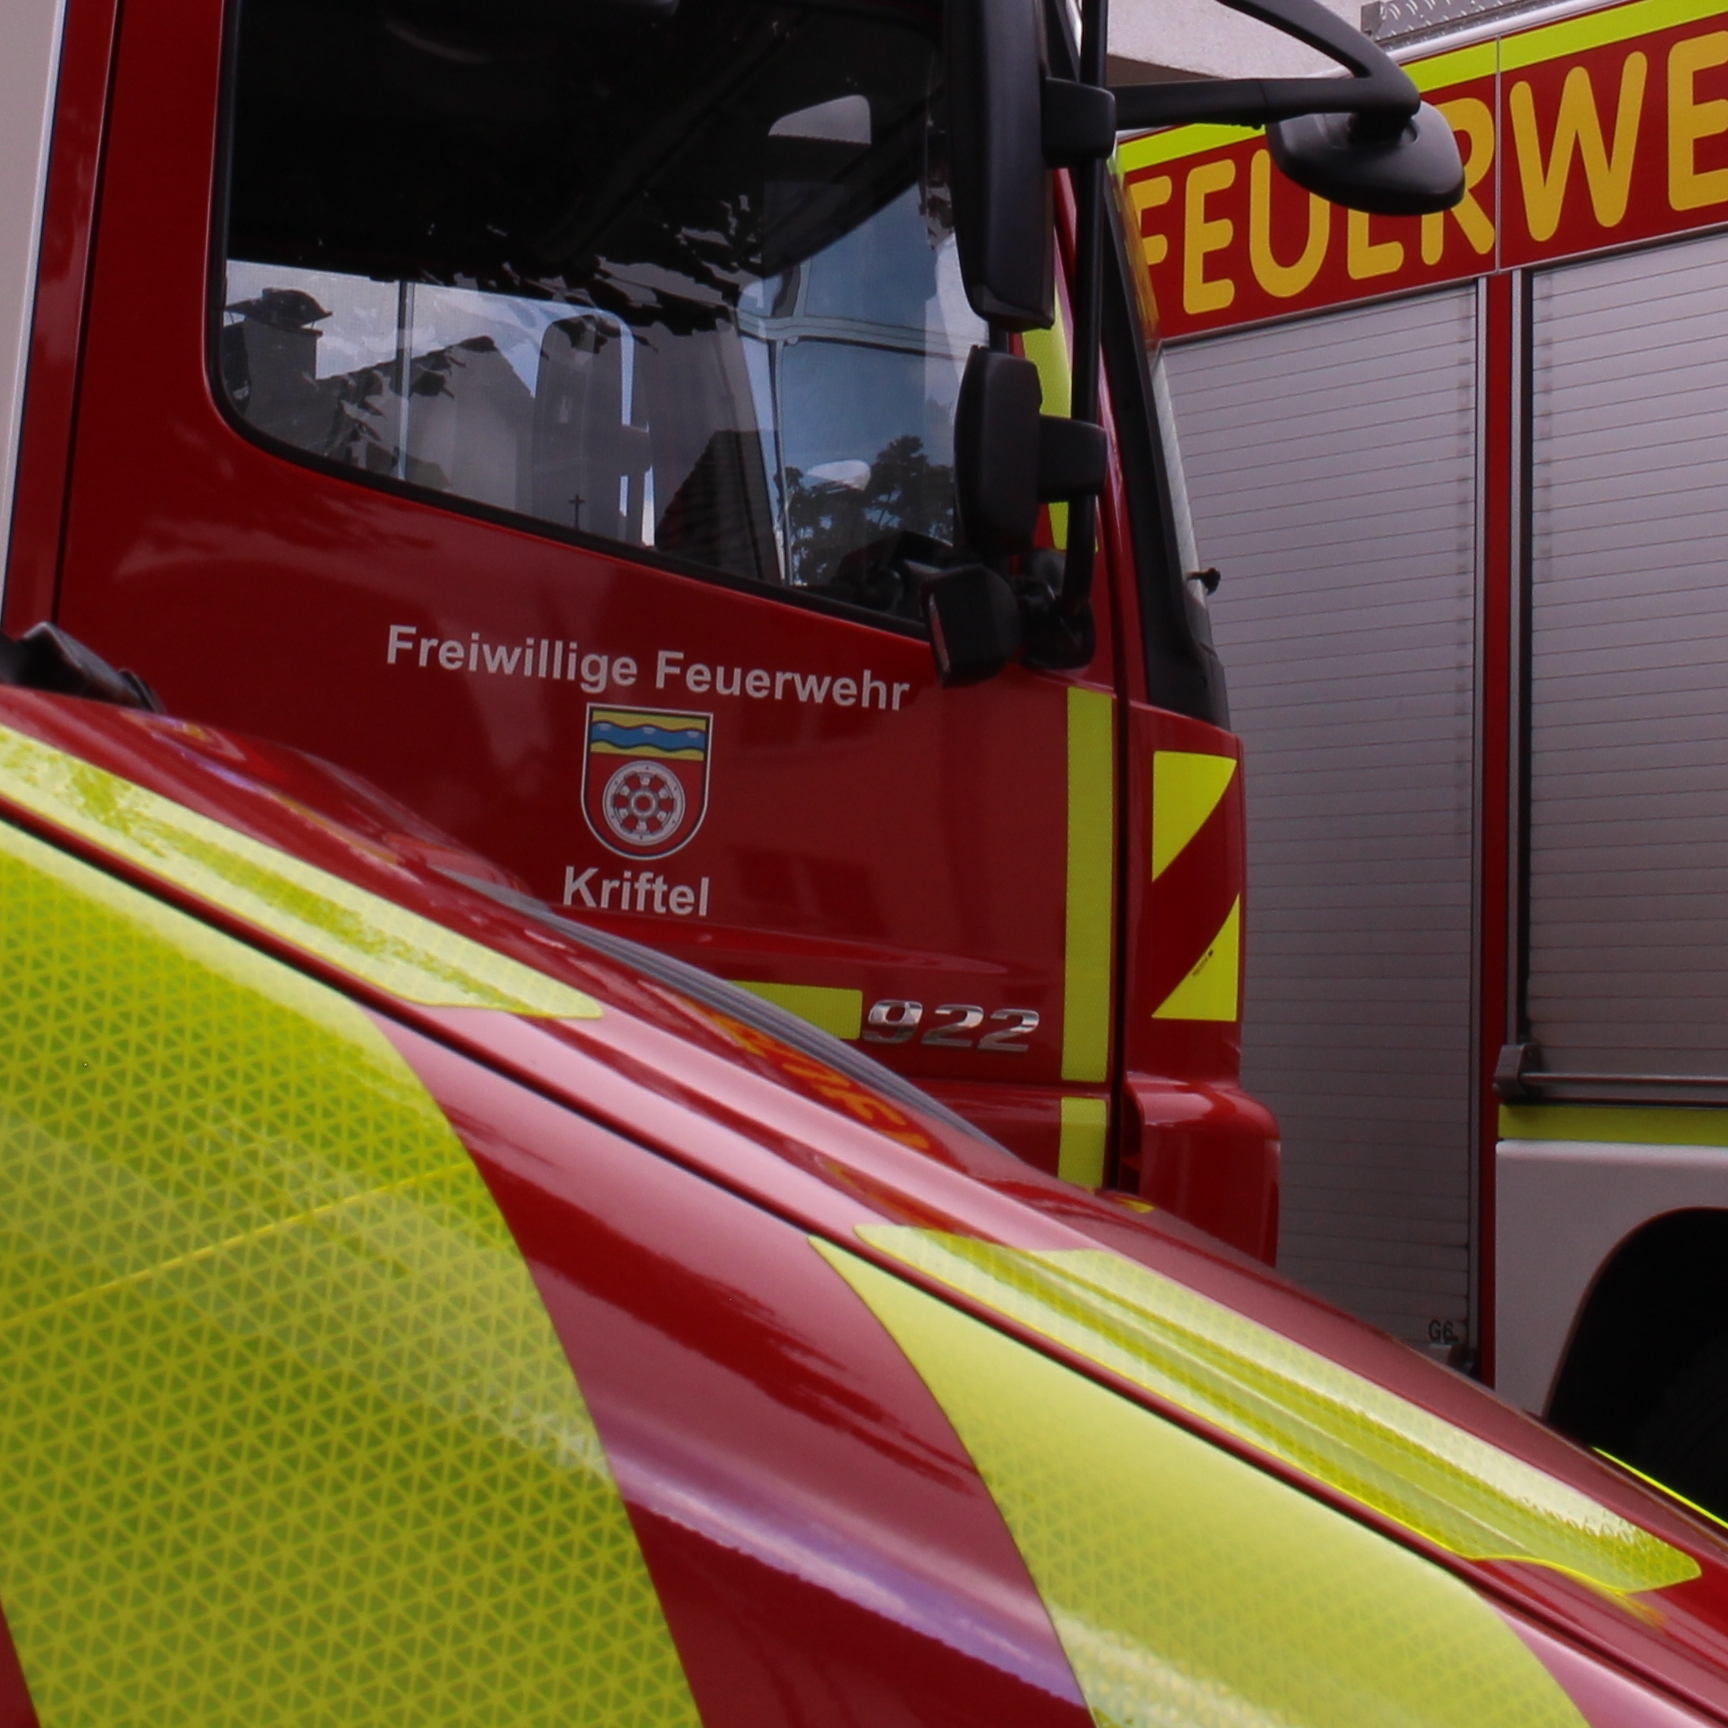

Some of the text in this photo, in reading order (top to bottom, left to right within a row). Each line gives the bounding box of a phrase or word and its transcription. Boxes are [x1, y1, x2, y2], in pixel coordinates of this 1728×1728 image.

[387, 624, 911, 712] Freiwillige Feuerwehr
[563, 865, 710, 917] Kriftel
[862, 999, 1040, 1053] 922
